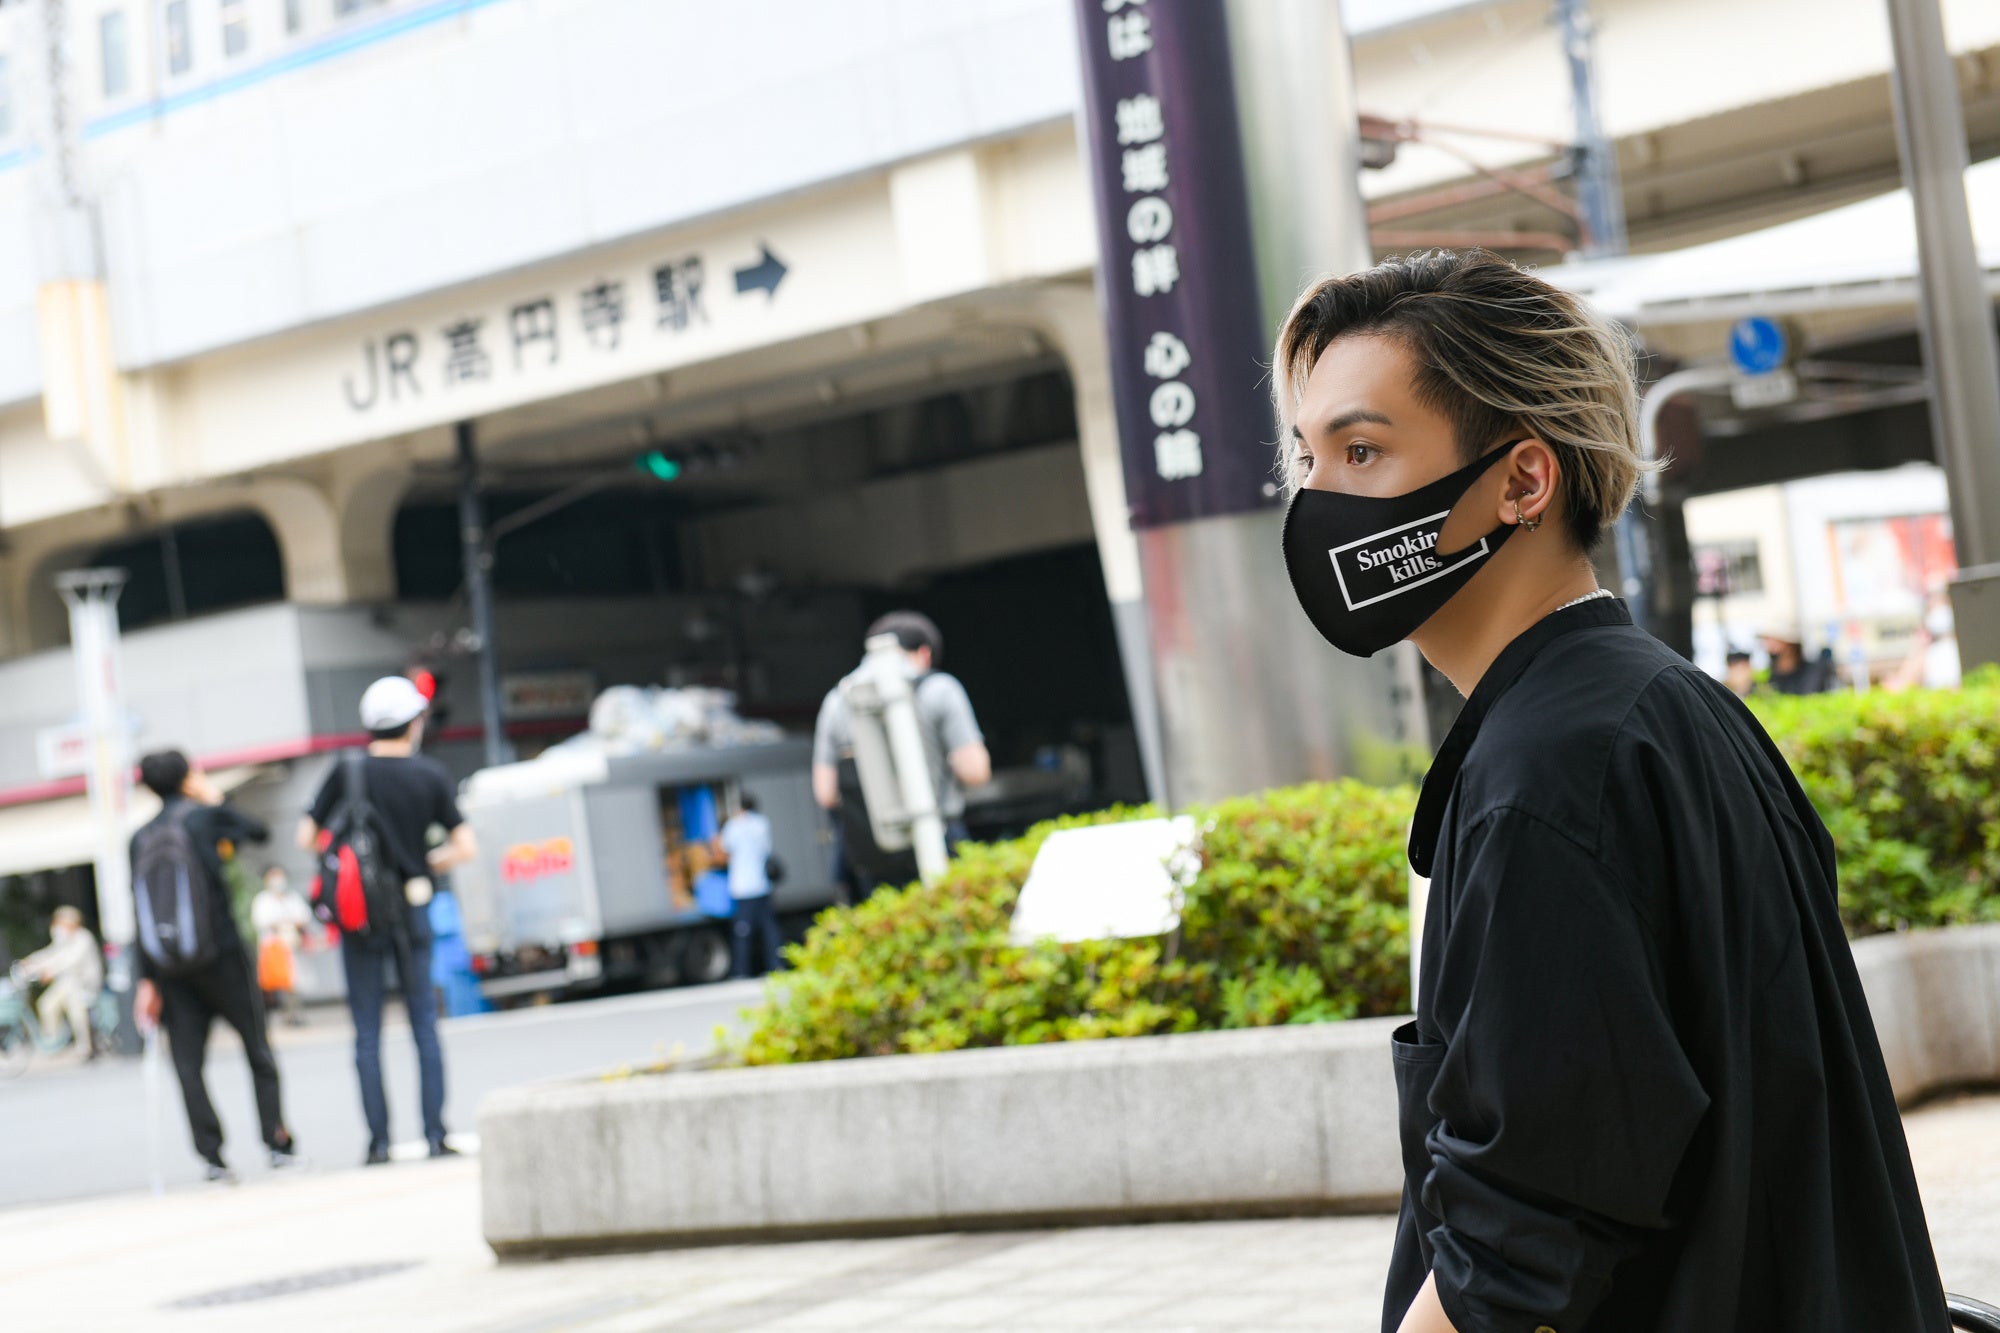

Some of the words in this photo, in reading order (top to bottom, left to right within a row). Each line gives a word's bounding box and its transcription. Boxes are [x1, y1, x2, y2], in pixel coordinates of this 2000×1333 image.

[1103, 0, 1153, 61] は
[1115, 94, 1179, 297] 地域の絆
[1356, 530, 1439, 572] Smokin
